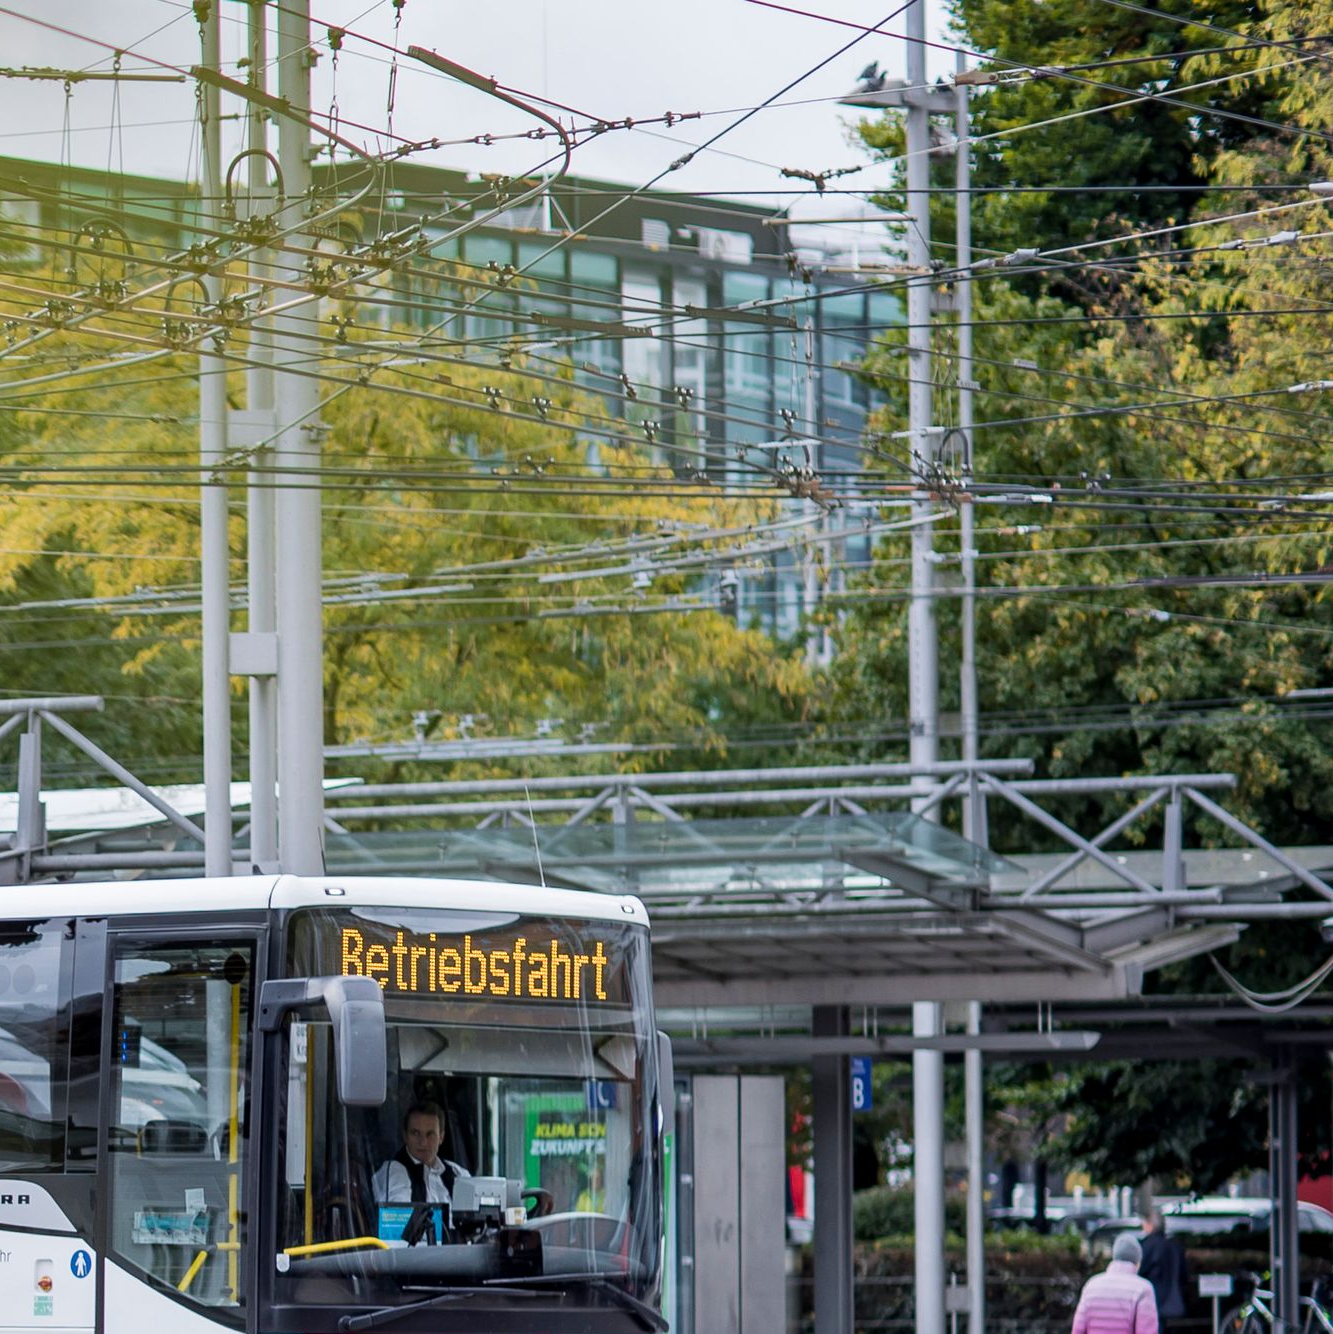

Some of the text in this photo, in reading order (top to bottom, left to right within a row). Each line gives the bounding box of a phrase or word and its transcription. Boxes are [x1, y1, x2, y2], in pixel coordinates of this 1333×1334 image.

[341, 927, 608, 1000] Betriebsfahrt
[535, 1122, 575, 1138] KLIMA
[530, 1139, 593, 1156] ZUKUNFT
